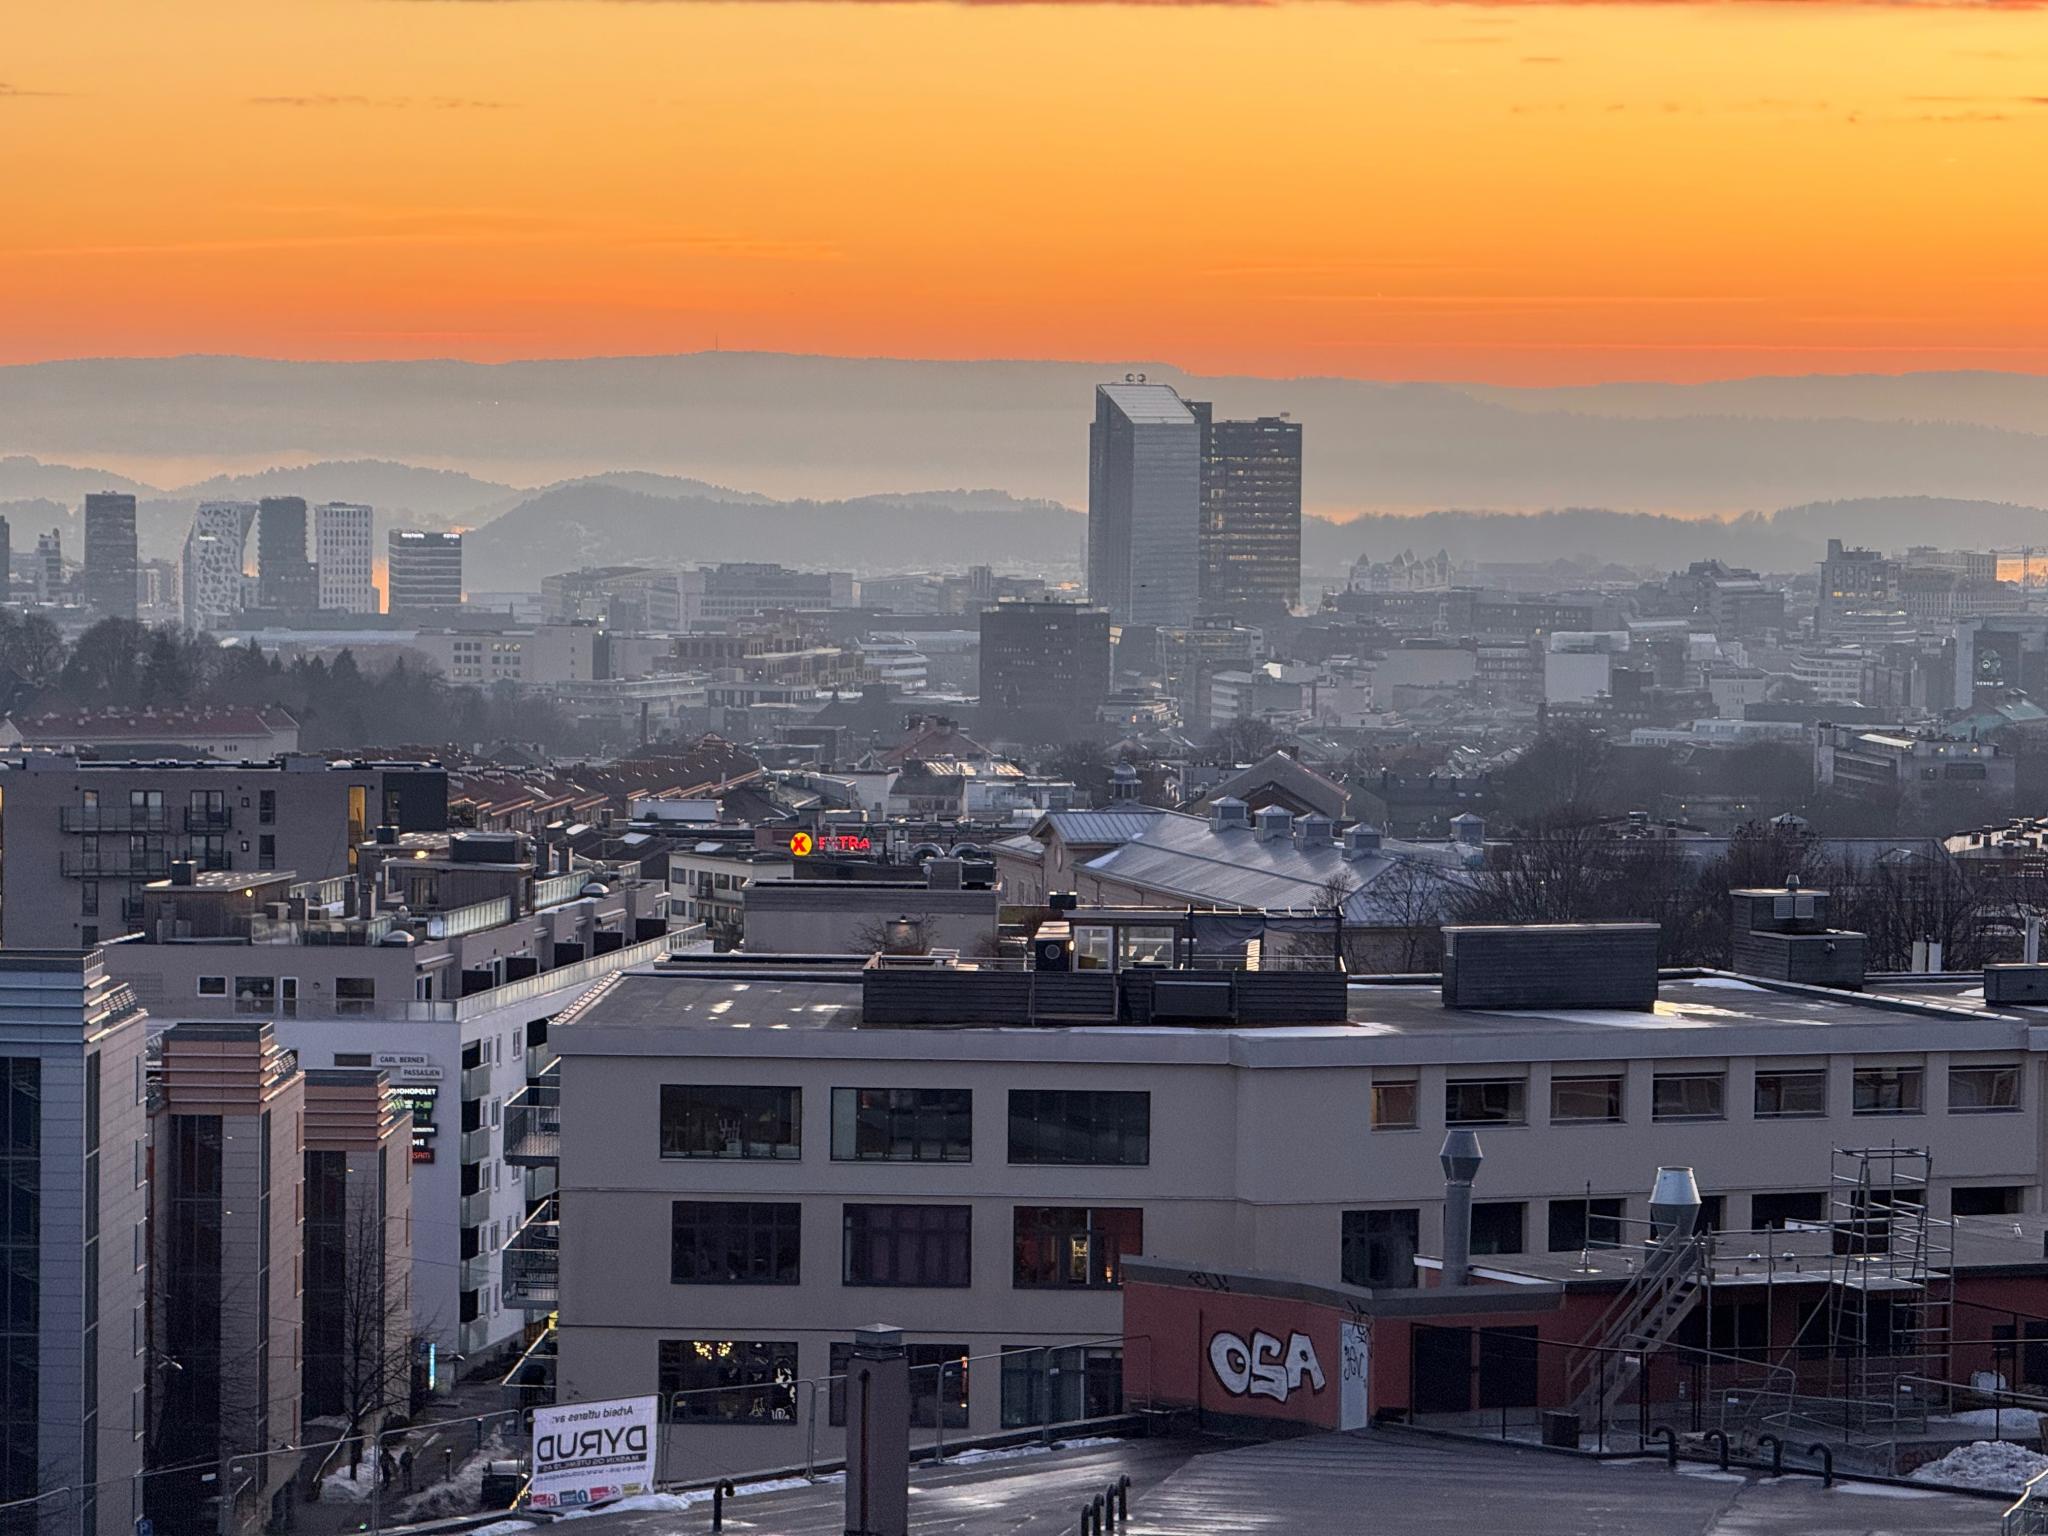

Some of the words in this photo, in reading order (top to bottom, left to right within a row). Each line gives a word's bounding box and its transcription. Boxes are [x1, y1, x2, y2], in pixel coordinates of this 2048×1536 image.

[818, 835, 871, 850] ETRA
[380, 1055, 396, 1064] CARL
[399, 1055, 425, 1064] BERNER
[403, 1068, 441, 1077] PASSASJEN
